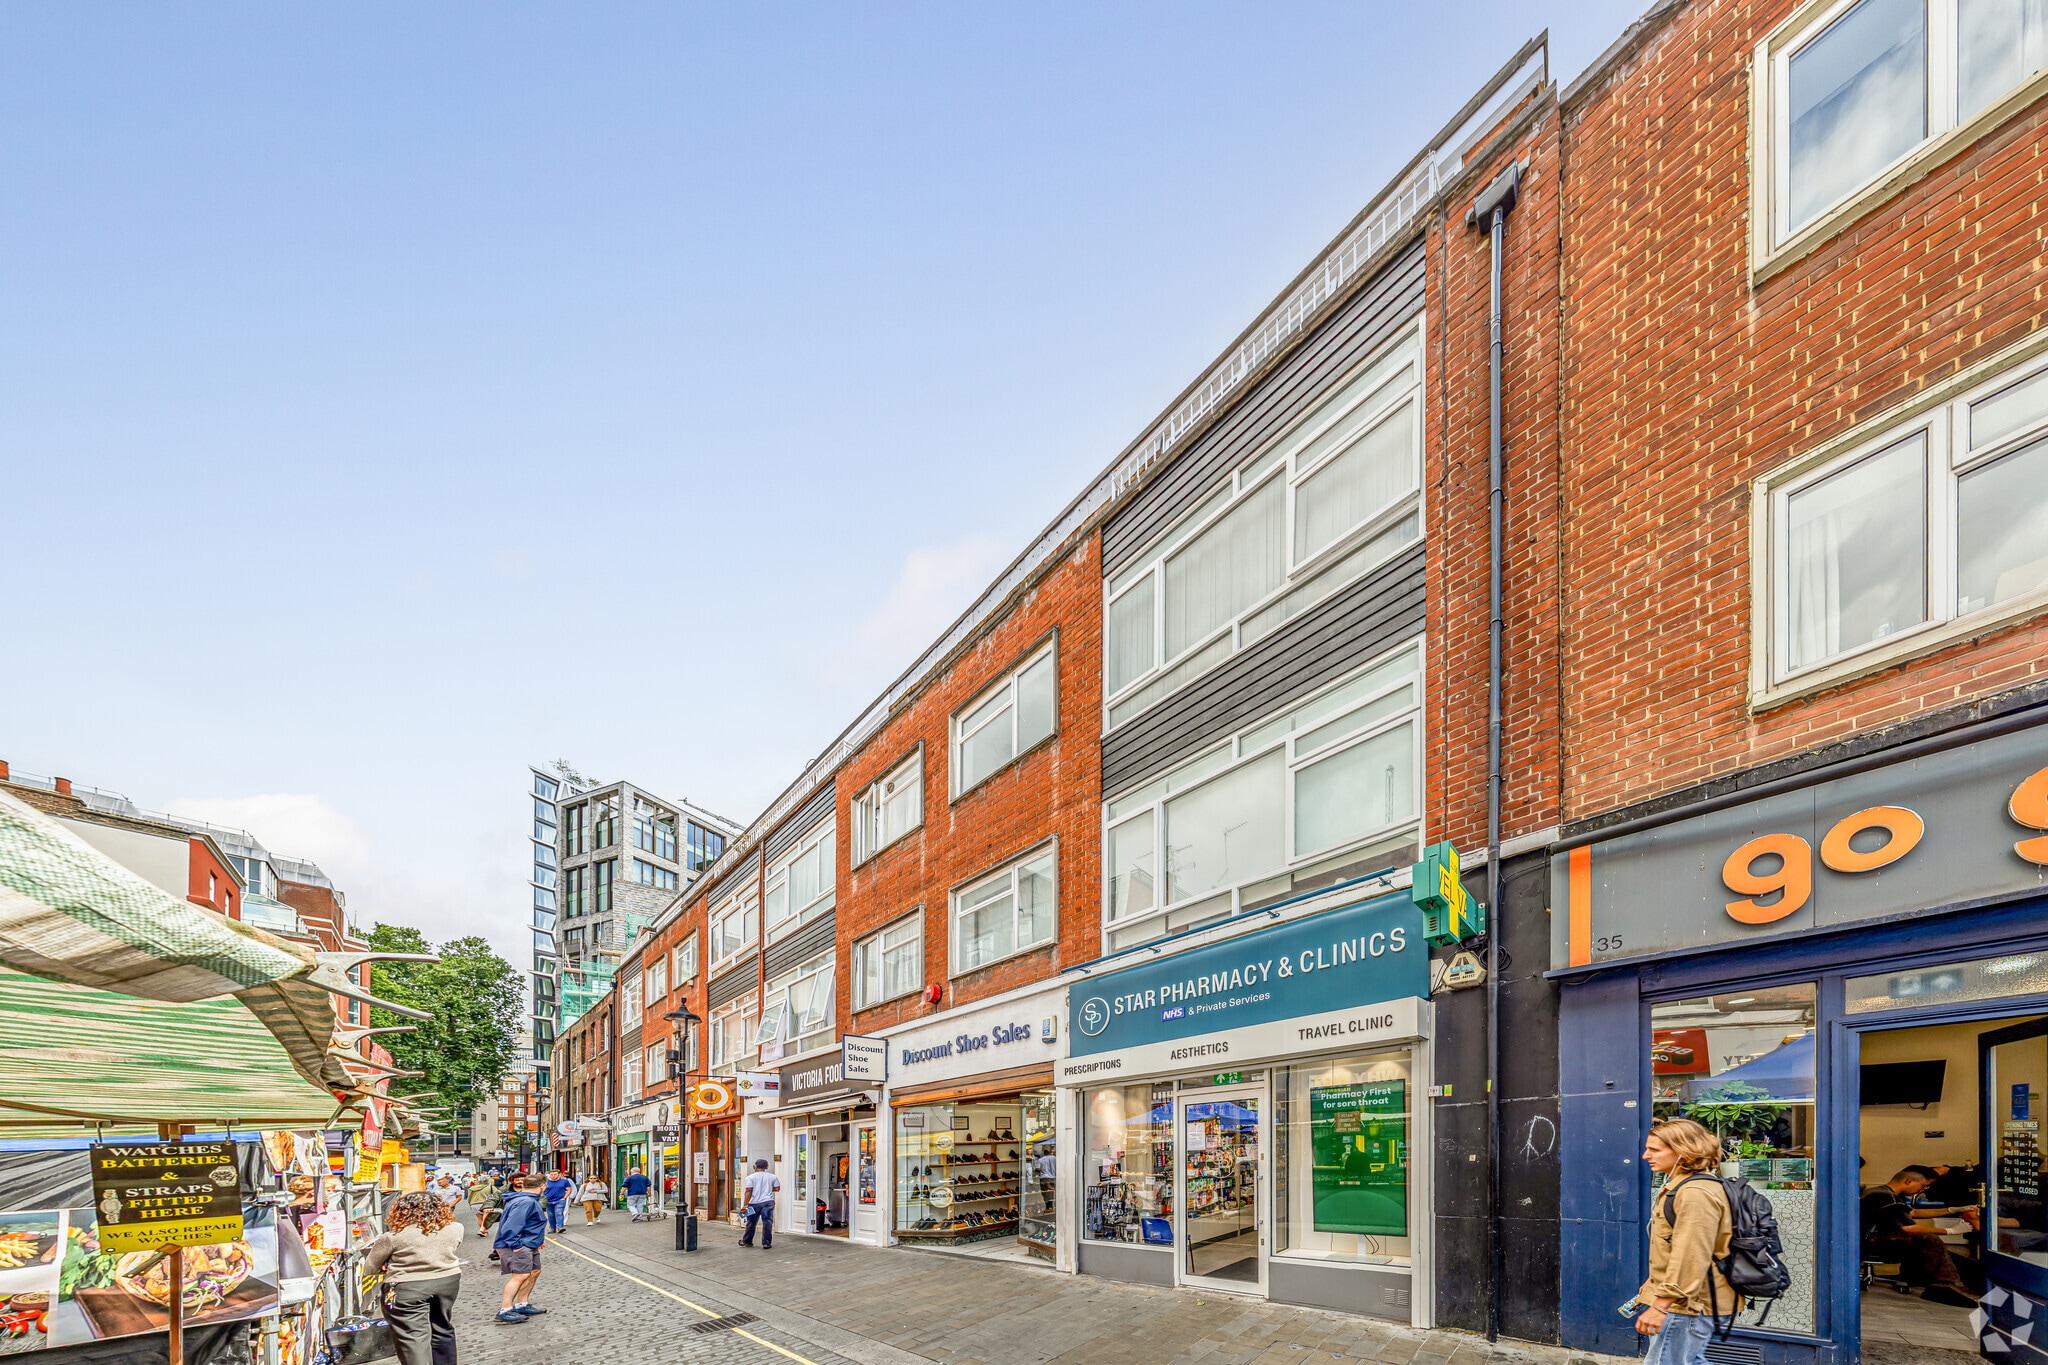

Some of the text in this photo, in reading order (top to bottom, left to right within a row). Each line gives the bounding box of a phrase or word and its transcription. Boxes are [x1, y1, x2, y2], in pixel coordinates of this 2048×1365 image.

[1722, 805, 1925, 925] go
[1596, 934, 1624, 952] 35
[1114, 927, 1407, 1015] STAR PHARMACY & CLINICS
[1163, 992, 1271, 1020] NHS & Private Services
[1298, 1014, 1394, 1040] TRAVEL CLINIC
[847, 1043, 883, 1054] Discount
[902, 1040, 952, 1066] Discount
[955, 1033, 988, 1054] Shoe
[992, 1022, 1031, 1046] Sales
[1170, 1041, 1229, 1060] AESTHETICS
[848, 1054, 868, 1062] Shoe
[848, 1064, 869, 1073] Sales
[1064, 1058, 1122, 1076] PRESCRIPTIONS
[792, 1068, 823, 1092] VICTORIA
[1320, 1087, 1392, 1100] Pharmacy First
[1323, 1097, 1389, 1109] for sore throat
[618, 1112, 645, 1131] Costcutter
[108, 1144, 222, 1157] WATCHES
[100, 1155, 231, 1169] BATTERIES
[160, 1171, 179, 1181] &
[125, 1184, 214, 1197] STRAPS
[2019, 1186, 2038, 1195] CLOSED
[127, 1195, 214, 1208] FITTED
[139, 1206, 205, 1219] HERE
[106, 1222, 237, 1239] WE ALSO REPAIR
[138, 1232, 213, 1244] WATCHES
